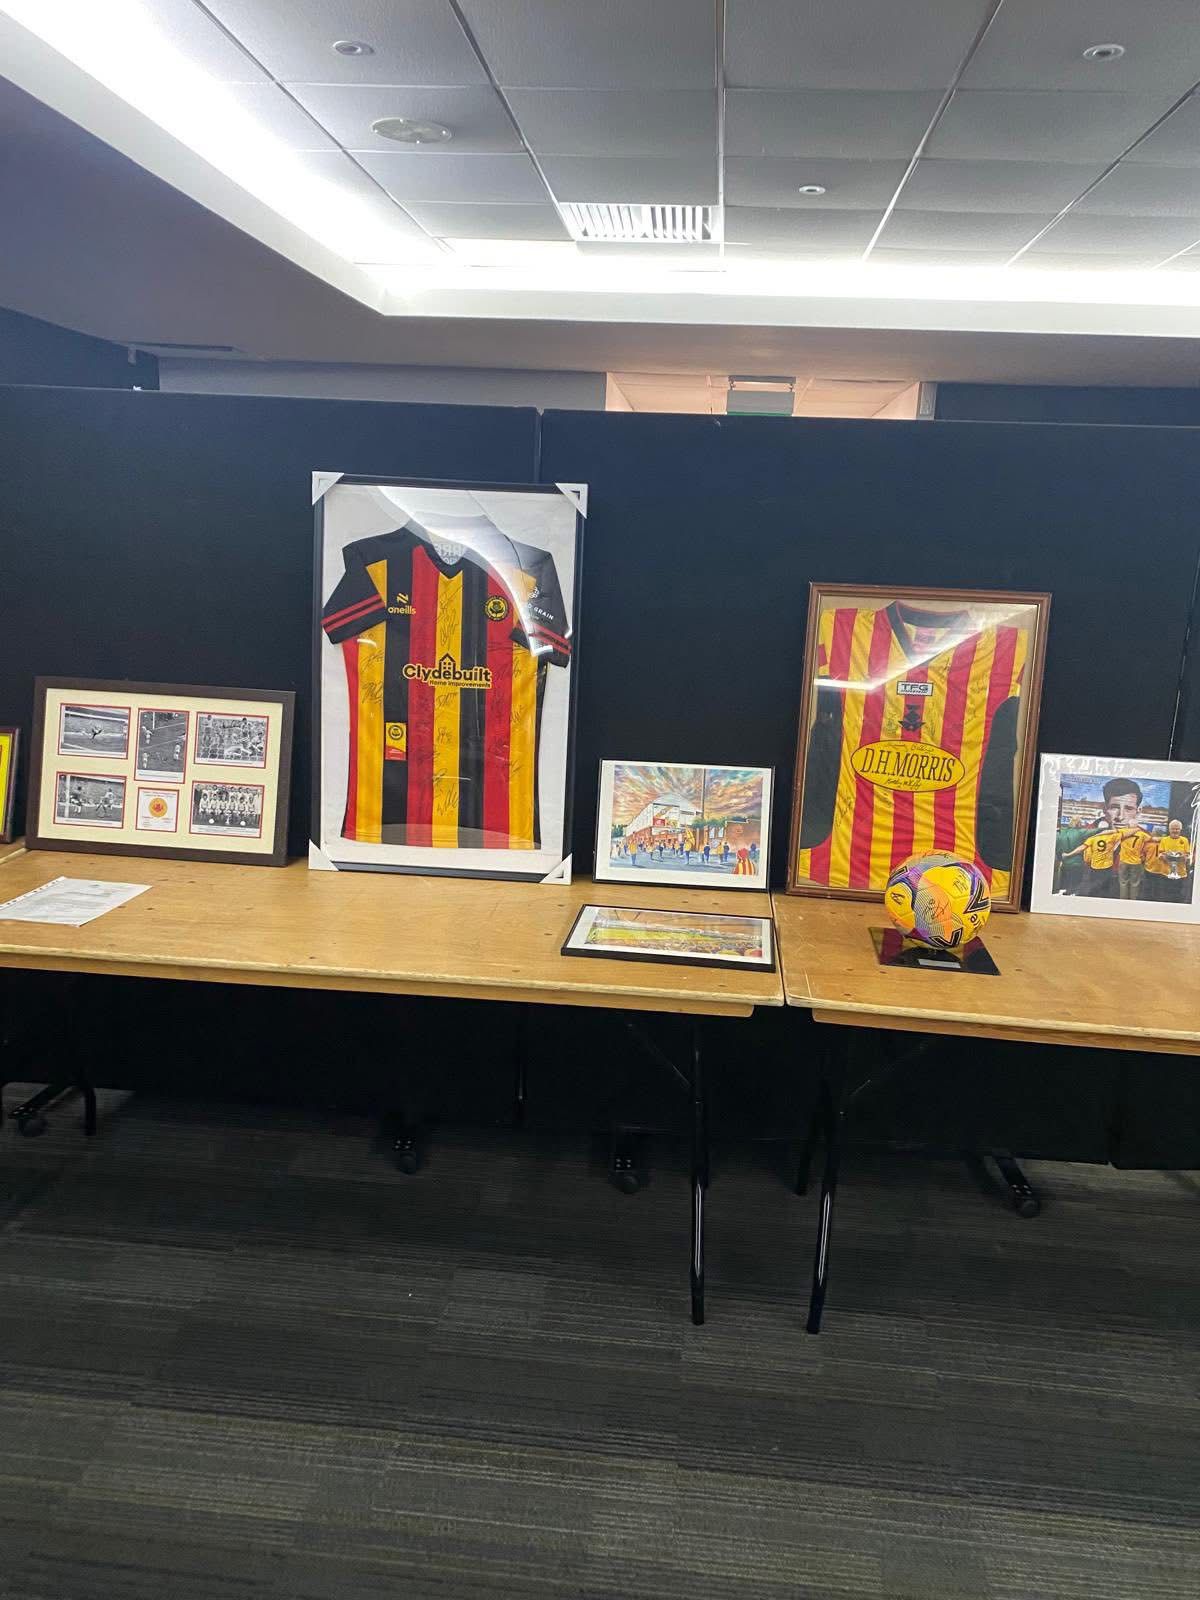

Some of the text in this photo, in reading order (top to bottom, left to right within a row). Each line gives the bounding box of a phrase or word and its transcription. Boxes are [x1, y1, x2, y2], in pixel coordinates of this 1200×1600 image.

[533, 606, 554, 620] GRAIN
[403, 664, 491, 682] Clydebuilt
[901, 683, 929, 691] TFG
[1097, 840, 1107, 852] 9
[1131, 835, 1140, 848] 7
